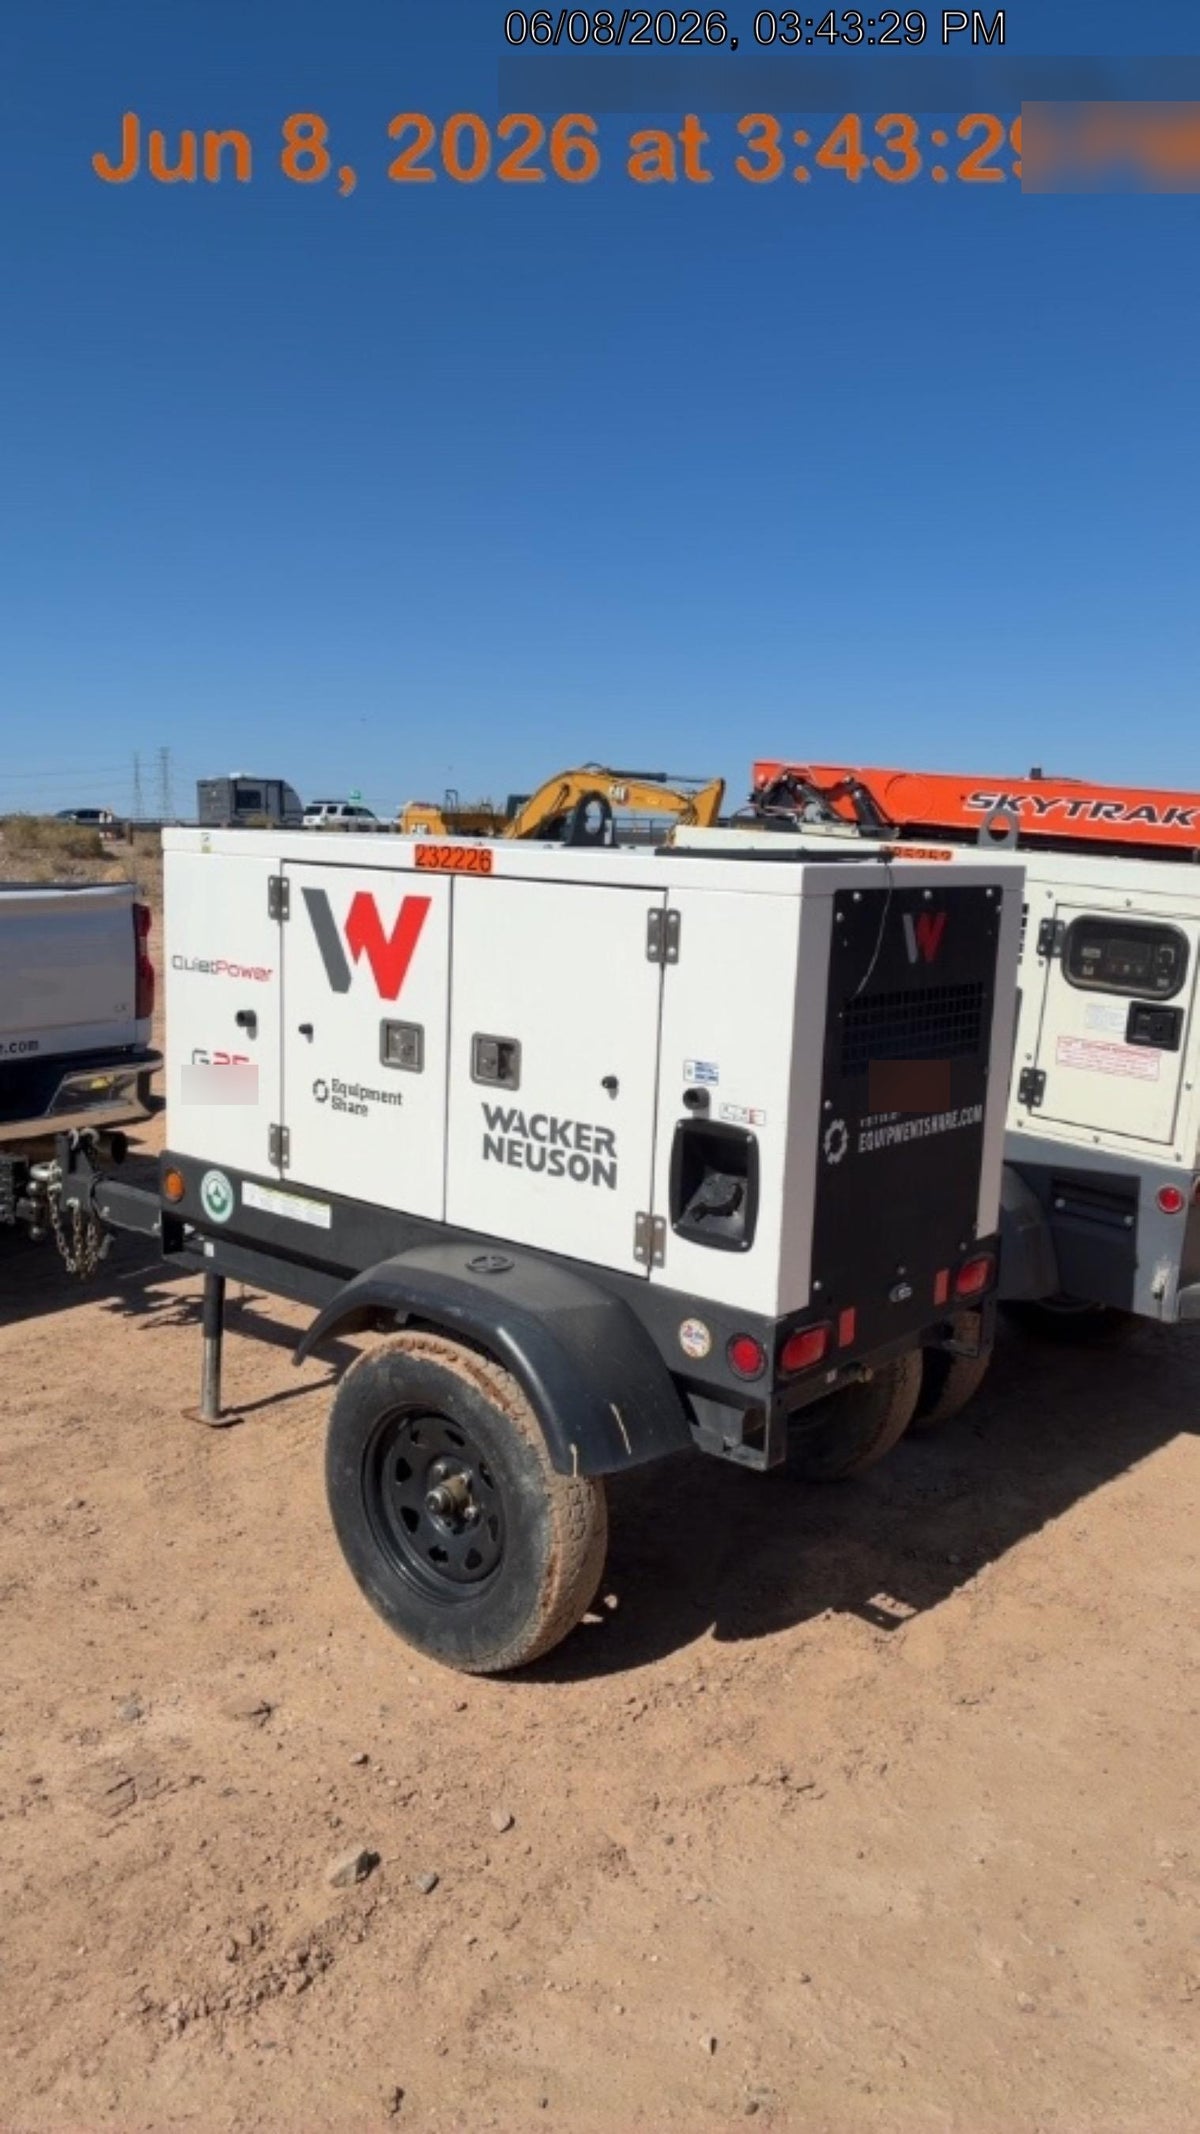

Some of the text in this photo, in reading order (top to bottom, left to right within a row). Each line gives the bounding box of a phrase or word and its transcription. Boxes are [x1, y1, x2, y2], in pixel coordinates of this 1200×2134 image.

[963, 790, 1199, 829] SKYTRAK
[415, 843, 492, 874] 232226
[171, 954, 274, 983] QuietPower
[331, 1078, 403, 1106] Equipment
[331, 1095, 368, 1117] Share
[481, 1101, 617, 1160] WACKER
[857, 1103, 983, 1154] EQUIPMENTSHARE.COM
[483, 1133, 617, 1190] NEUSON
